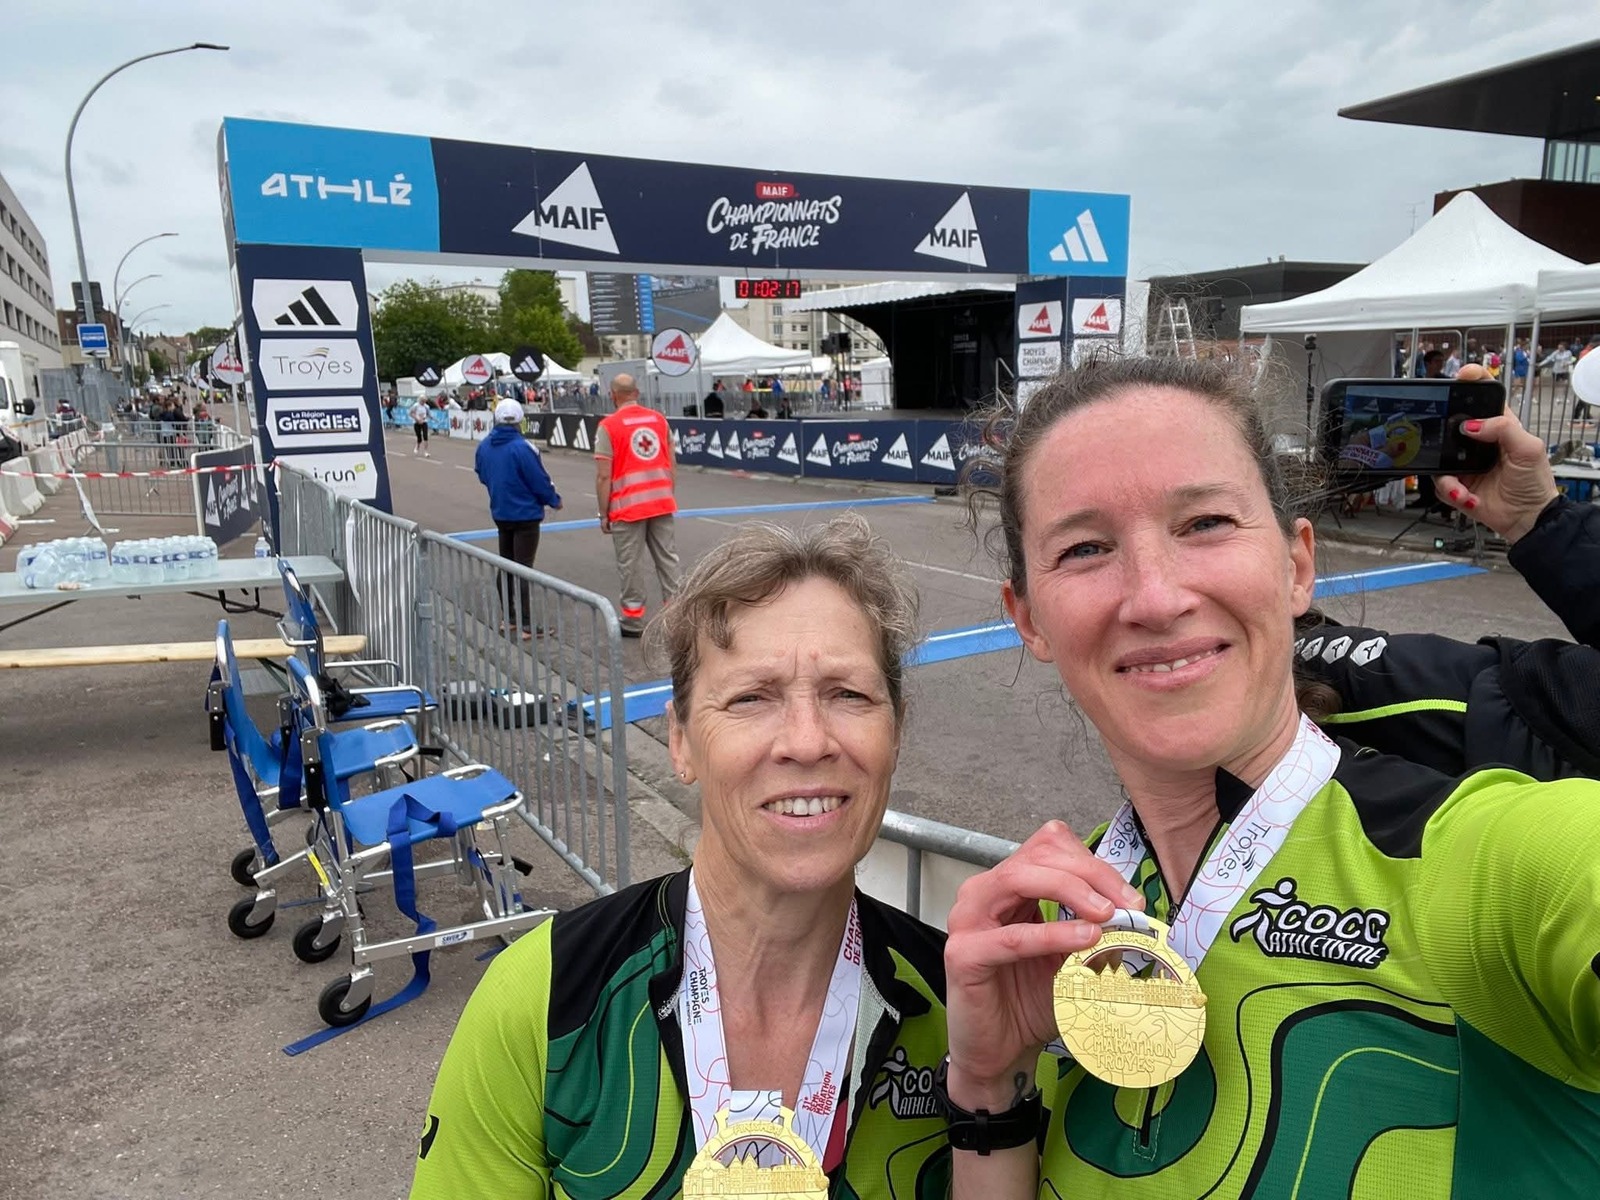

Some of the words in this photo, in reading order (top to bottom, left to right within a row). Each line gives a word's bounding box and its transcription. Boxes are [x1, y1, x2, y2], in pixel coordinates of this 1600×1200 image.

[261, 173, 412, 206] ATHLÉ
[762, 185, 788, 196] MAIF
[534, 203, 605, 231] MAIF
[706, 195, 842, 234] CHAMPIONNATS
[729, 232, 748, 251] DE
[752, 224, 820, 256] FRANCE
[929, 227, 979, 248] MAIF
[738, 280, 799, 297] 01:02:17
[662, 348, 688, 357] MAIF
[272, 356, 353, 380] Troyes
[302, 411, 325, 419] Région
[810, 450, 828, 459] MAIF
[887, 451, 909, 460] MAIF
[928, 451, 951, 461] MAIF
[1217, 822, 1272, 879] Troyes
[853, 947, 861, 966] DE
[699, 966, 710, 1003] TROYES
[689, 970, 702, 1025] CHAMPAGNE
[1093, 1036, 1176, 1058] MARATHON
[1096, 1053, 1155, 1073] TROYES
[815, 1071, 832, 1115] MARATHON
[823, 1085, 837, 1116] TROYES
